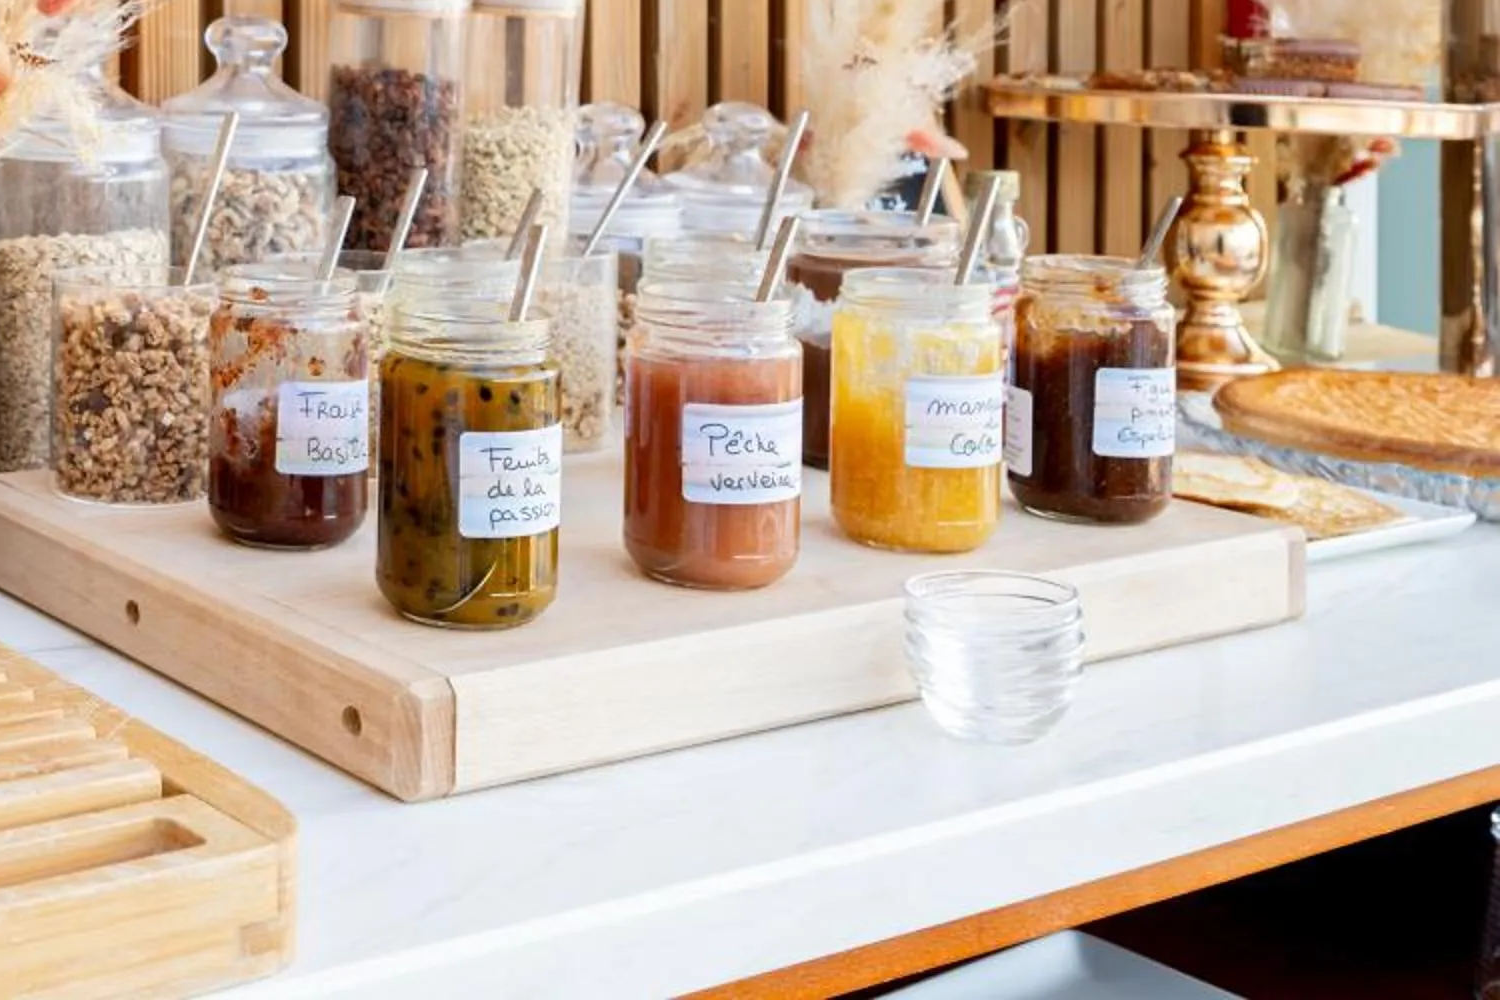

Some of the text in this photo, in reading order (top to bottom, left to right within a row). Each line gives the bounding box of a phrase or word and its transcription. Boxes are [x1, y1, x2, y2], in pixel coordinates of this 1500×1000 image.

[700, 423, 779, 456] Pêche
[488, 477, 547, 499] de la
[489, 503, 556, 530] passio
